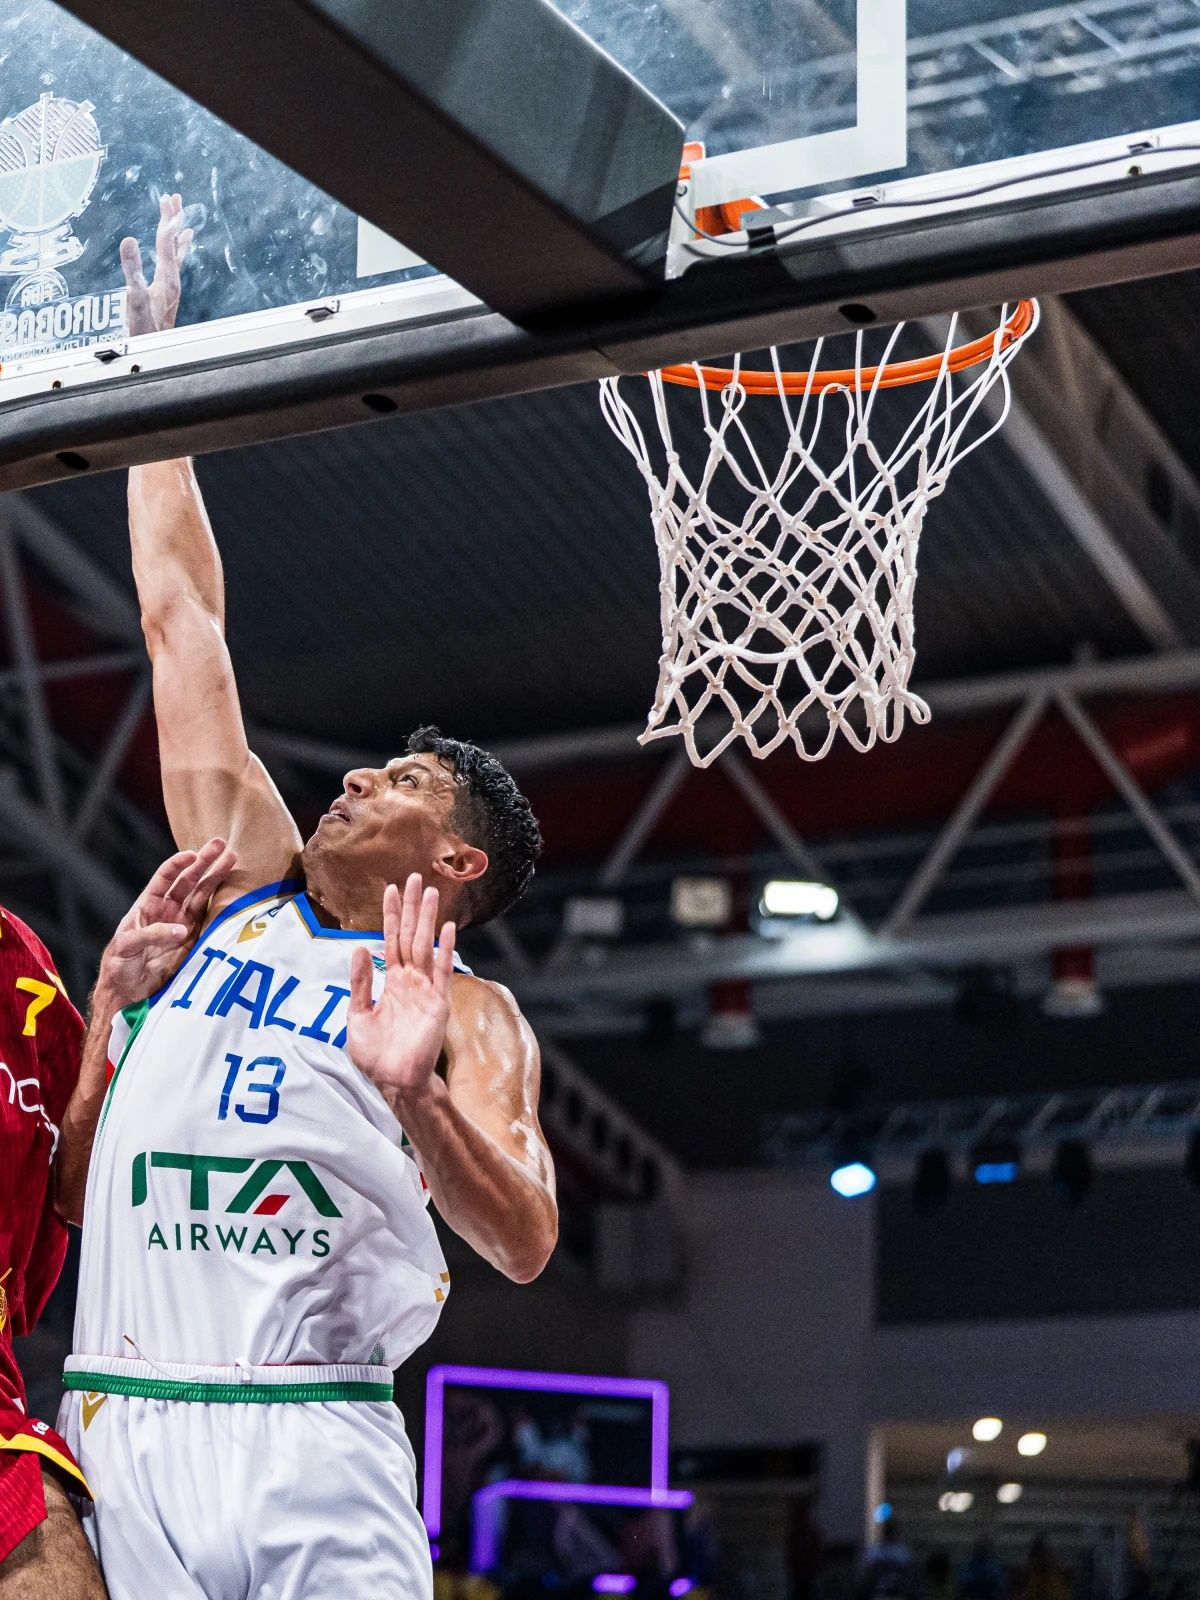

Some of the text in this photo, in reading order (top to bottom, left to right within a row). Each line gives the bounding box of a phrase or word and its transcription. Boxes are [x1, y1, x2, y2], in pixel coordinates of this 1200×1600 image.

[16, 976, 57, 1036] 7
[170, 946, 348, 1050] ITALI
[217, 1053, 287, 1125] 13
[131, 1150, 343, 1219] ITA
[148, 1222, 331, 1258] AIRWAYS
